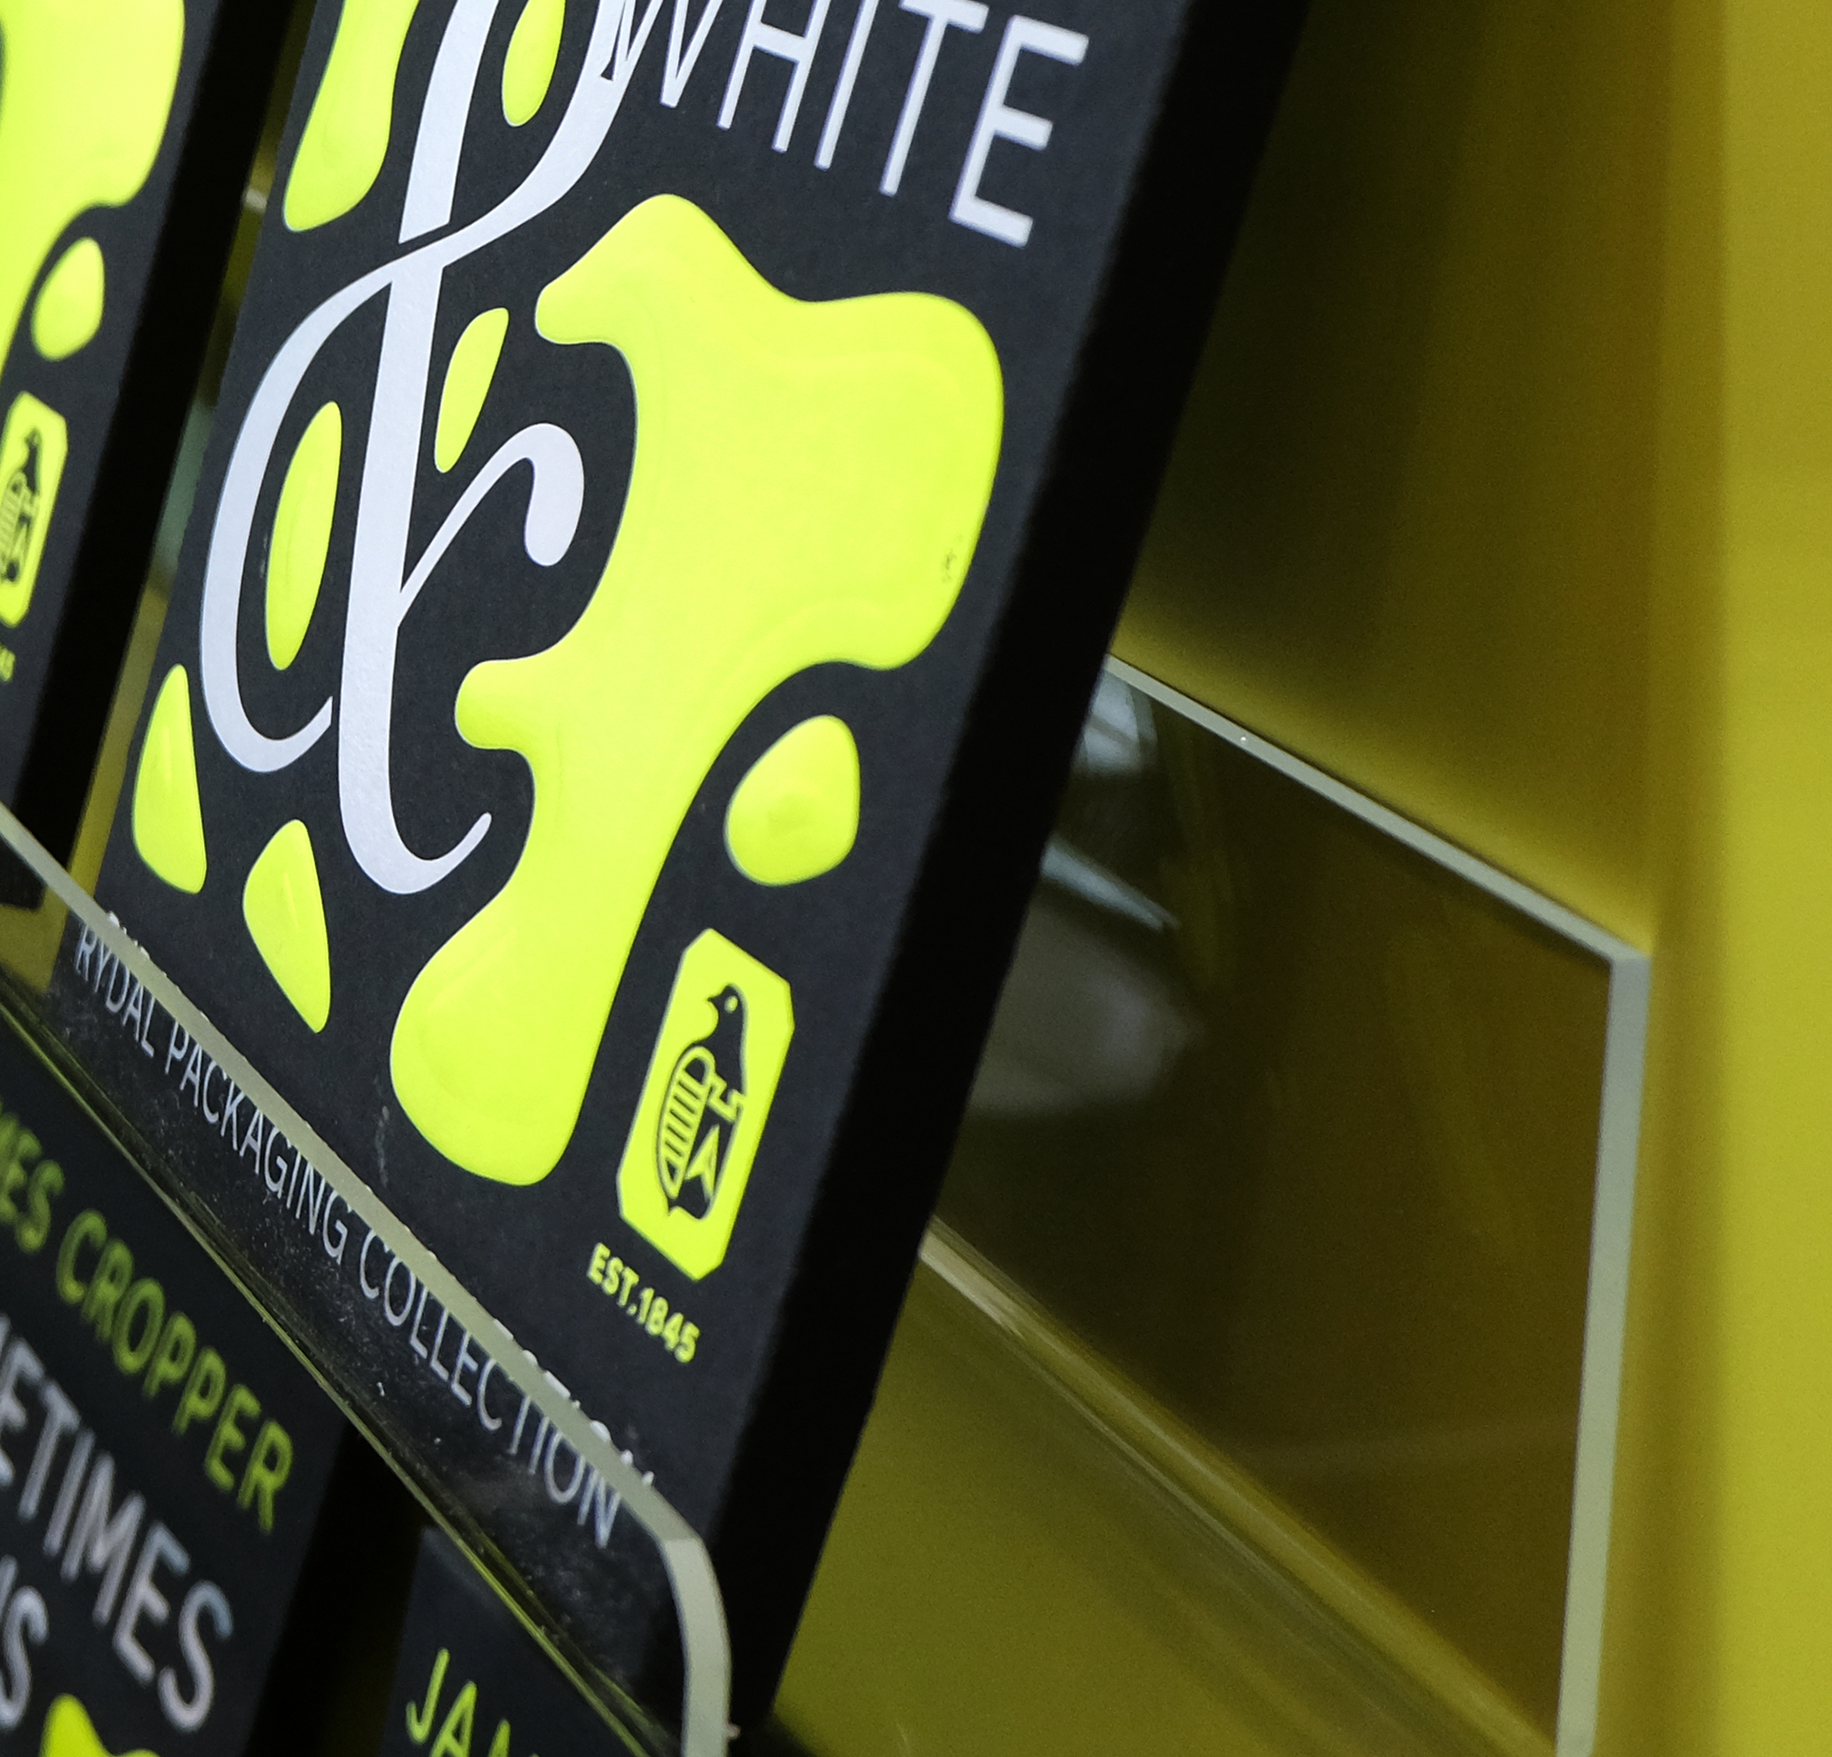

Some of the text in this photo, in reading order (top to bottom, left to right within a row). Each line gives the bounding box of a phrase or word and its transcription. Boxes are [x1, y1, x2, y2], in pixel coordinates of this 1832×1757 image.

[56, 1209, 294, 1532] CROPPER
[164, 1015, 352, 1266] PACKAGING
[358, 1226, 645, 1549] COLLECTION
[586, 1242, 701, 1364] EST.1845
